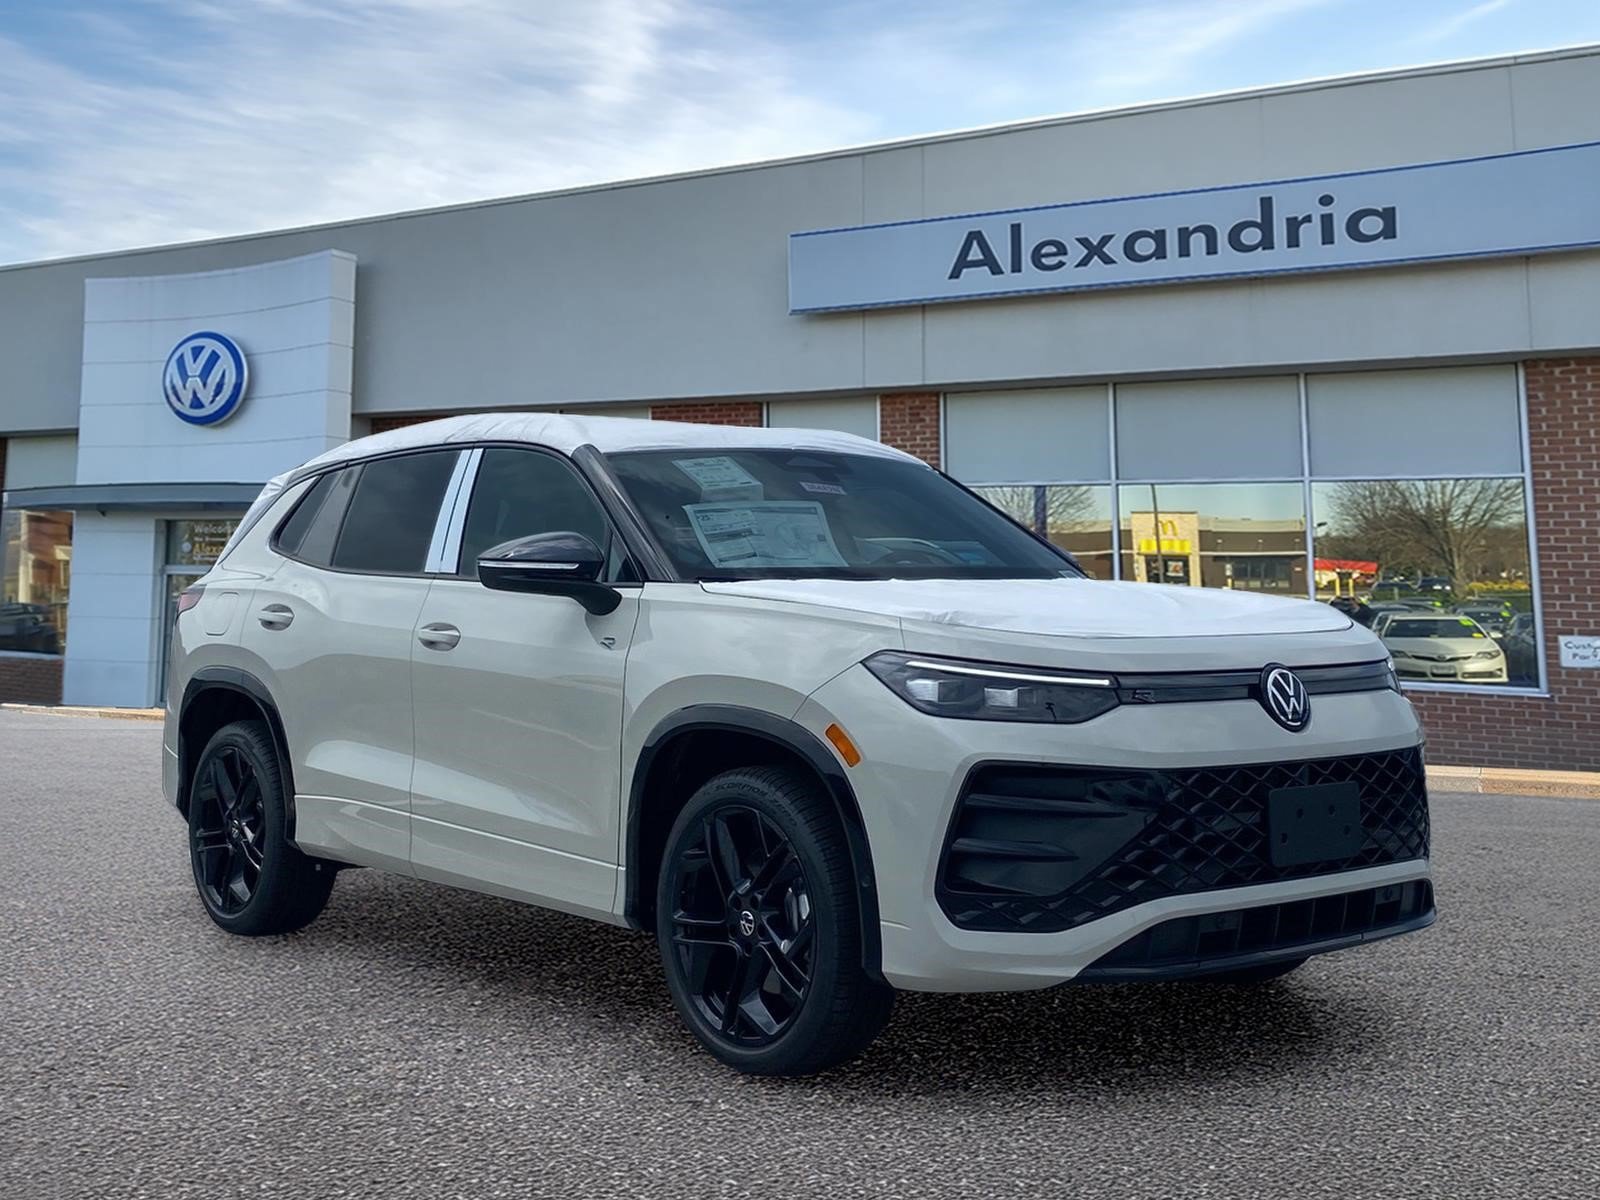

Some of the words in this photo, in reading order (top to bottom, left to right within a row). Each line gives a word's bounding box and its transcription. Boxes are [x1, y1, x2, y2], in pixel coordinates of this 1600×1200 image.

[947, 194, 1398, 280] Alexandria
[164, 332, 245, 424] VW
[1265, 667, 1306, 728] VW
